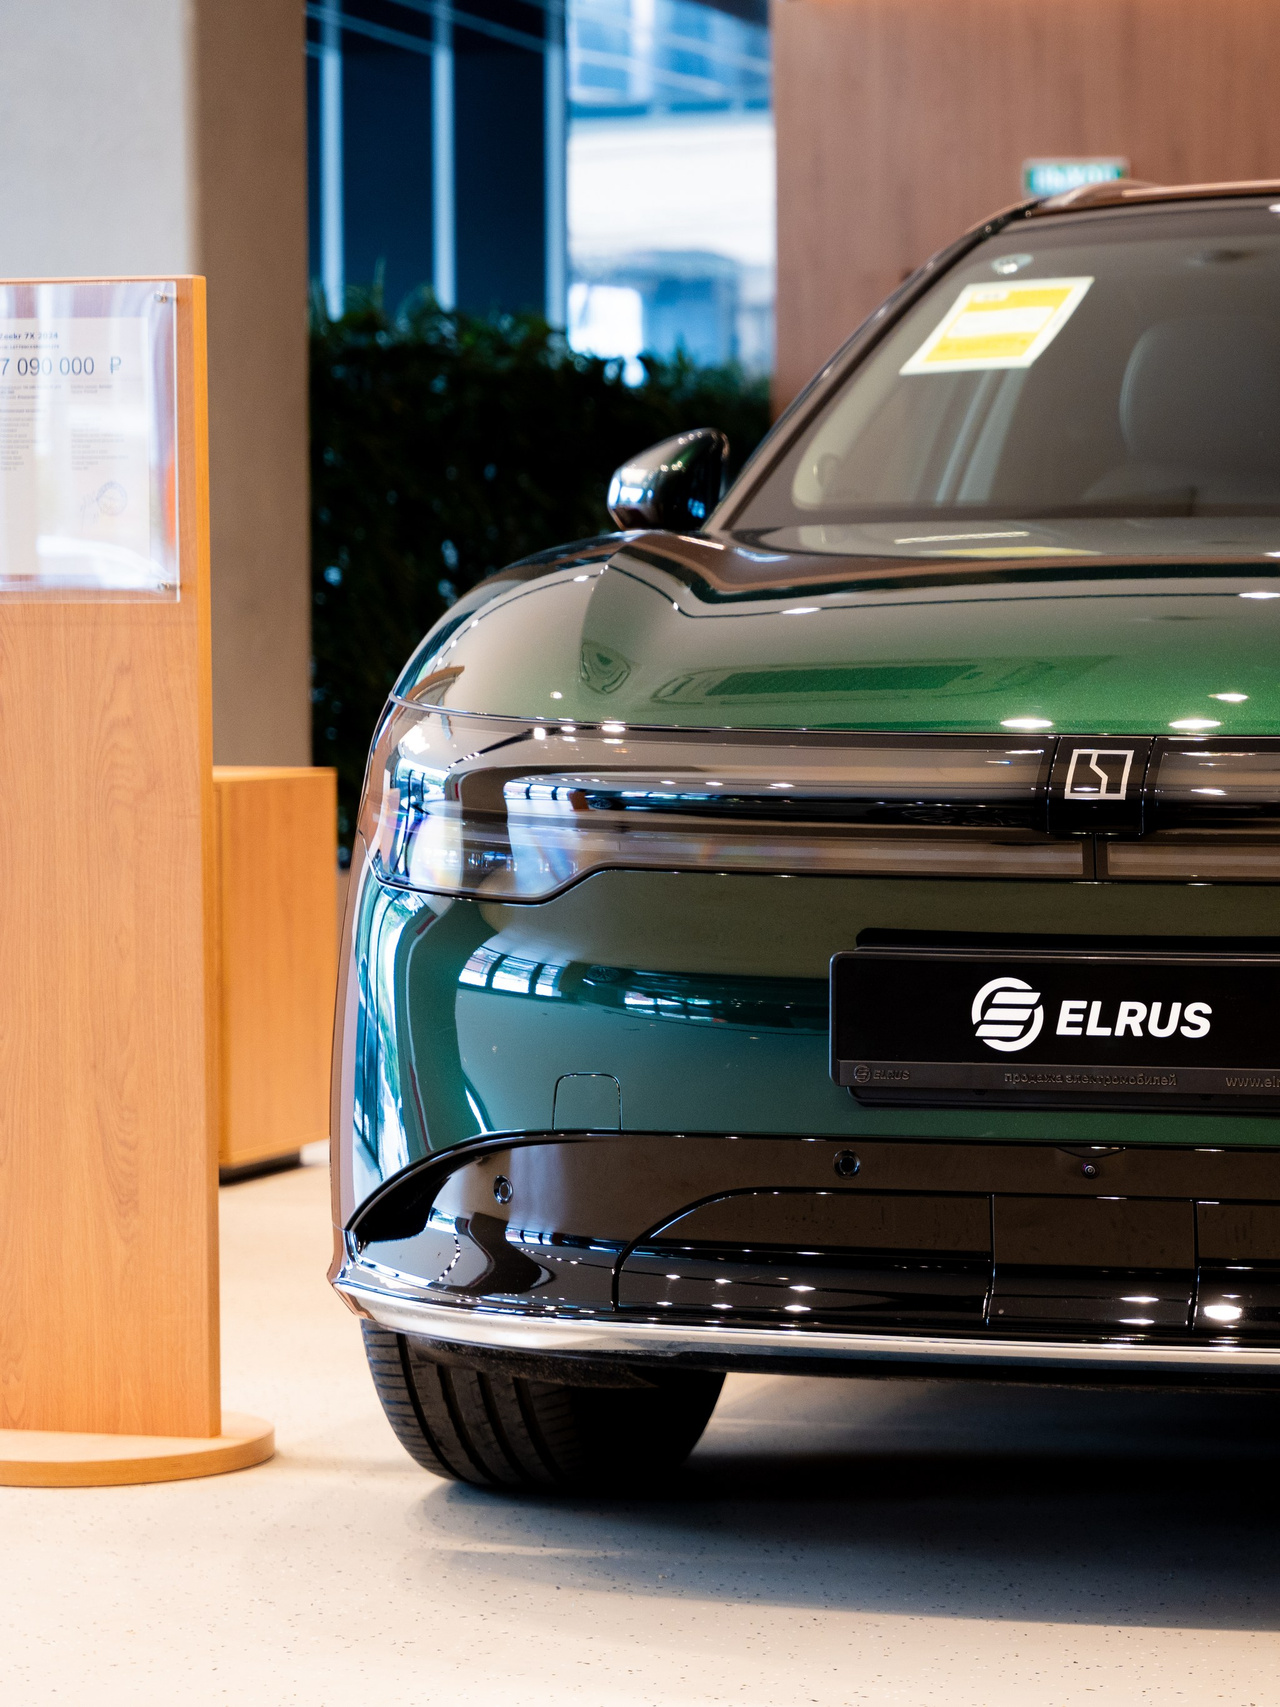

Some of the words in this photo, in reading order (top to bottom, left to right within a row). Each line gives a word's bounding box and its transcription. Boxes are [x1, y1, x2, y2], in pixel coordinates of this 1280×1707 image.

[0, 357, 10, 376] 7
[17, 357, 52, 376] 090
[60, 356, 95, 376] 000
[1056, 1000, 1213, 1038] ELRUS
[873, 1069, 911, 1081] ELRUS
[1004, 1072, 1063, 1085] продажа
[1065, 1072, 1178, 1087] электромобилей
